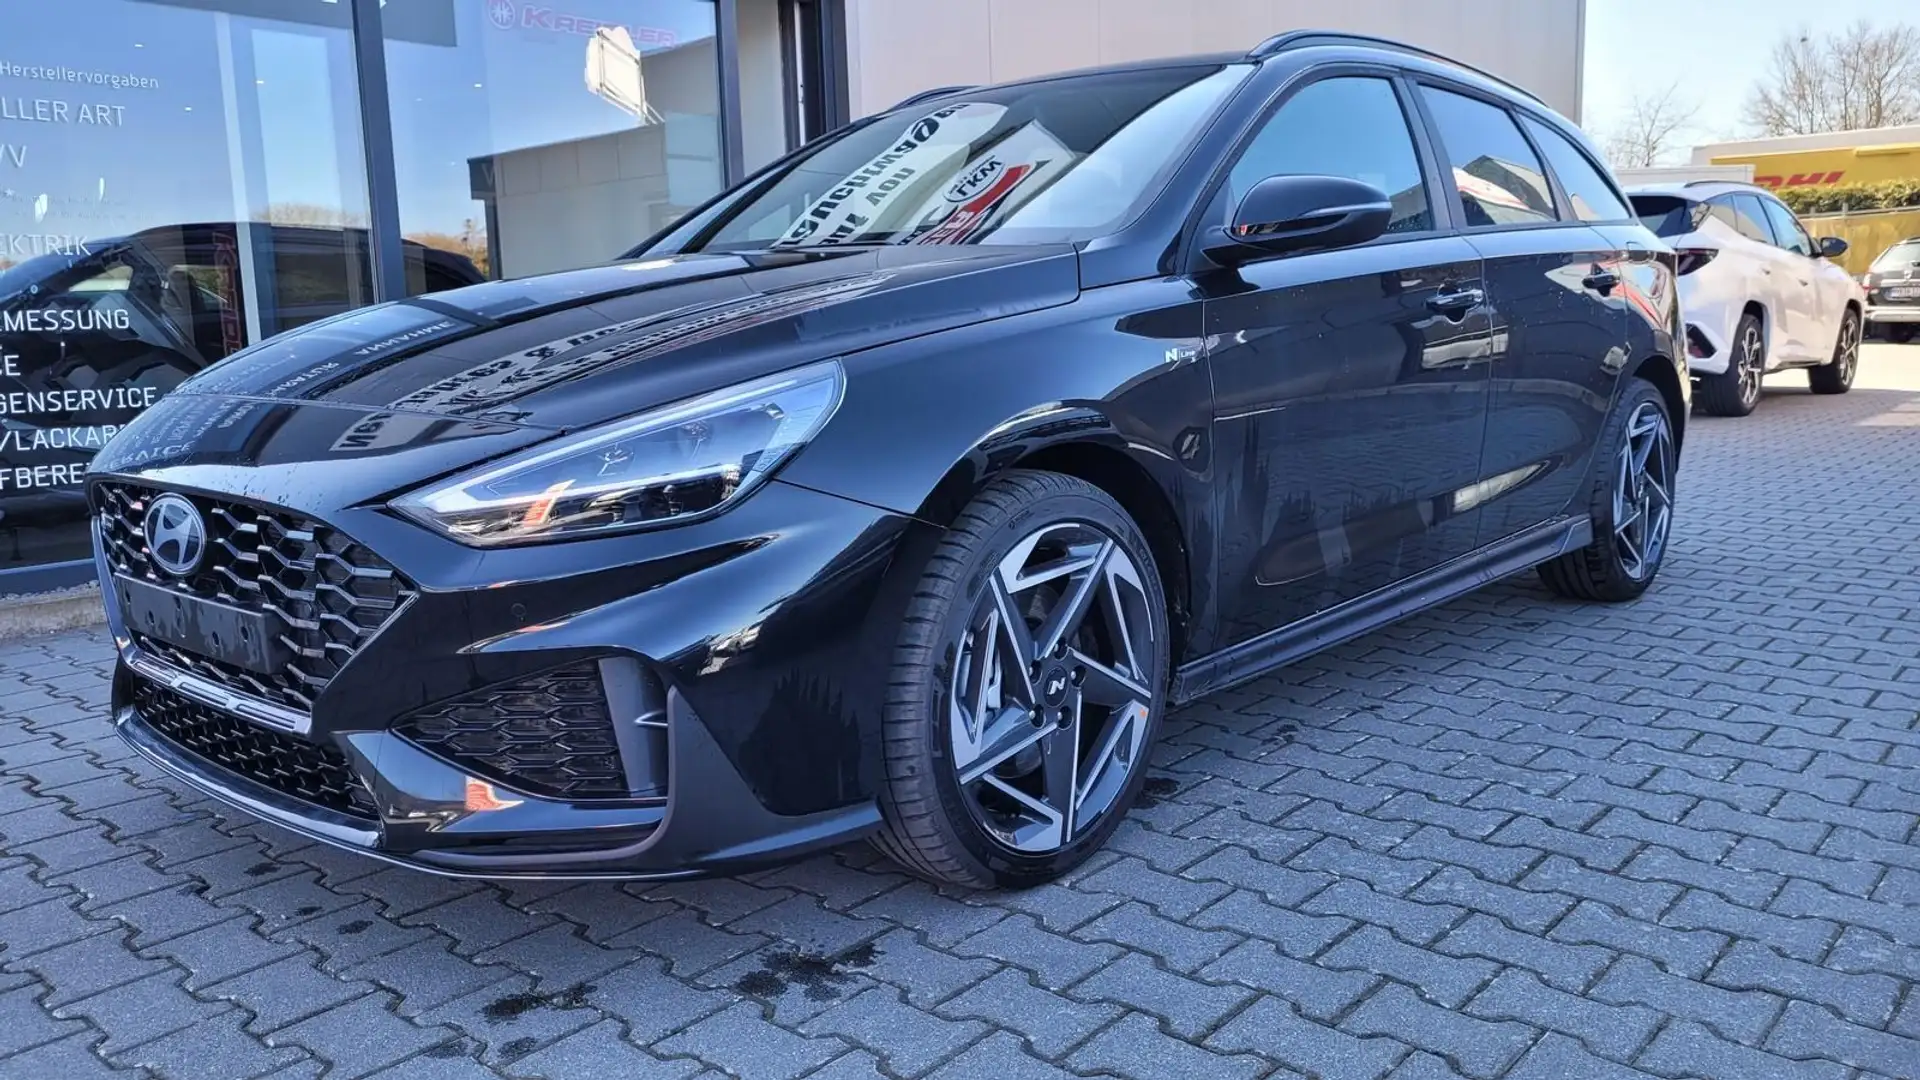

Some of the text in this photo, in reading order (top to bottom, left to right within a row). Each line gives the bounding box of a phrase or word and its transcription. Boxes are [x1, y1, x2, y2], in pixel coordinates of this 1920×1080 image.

[521, 5, 678, 47] KRELER
[0, 61, 159, 89] Herstellervorgaben
[78, 103, 126, 127] ART
[0, 143, 27, 168] V
[0, 309, 130, 332] MESSUNG
[0, 355, 21, 376] E
[0, 424, 124, 450] /LACKAR
[0, 462, 91, 490] FBERE
